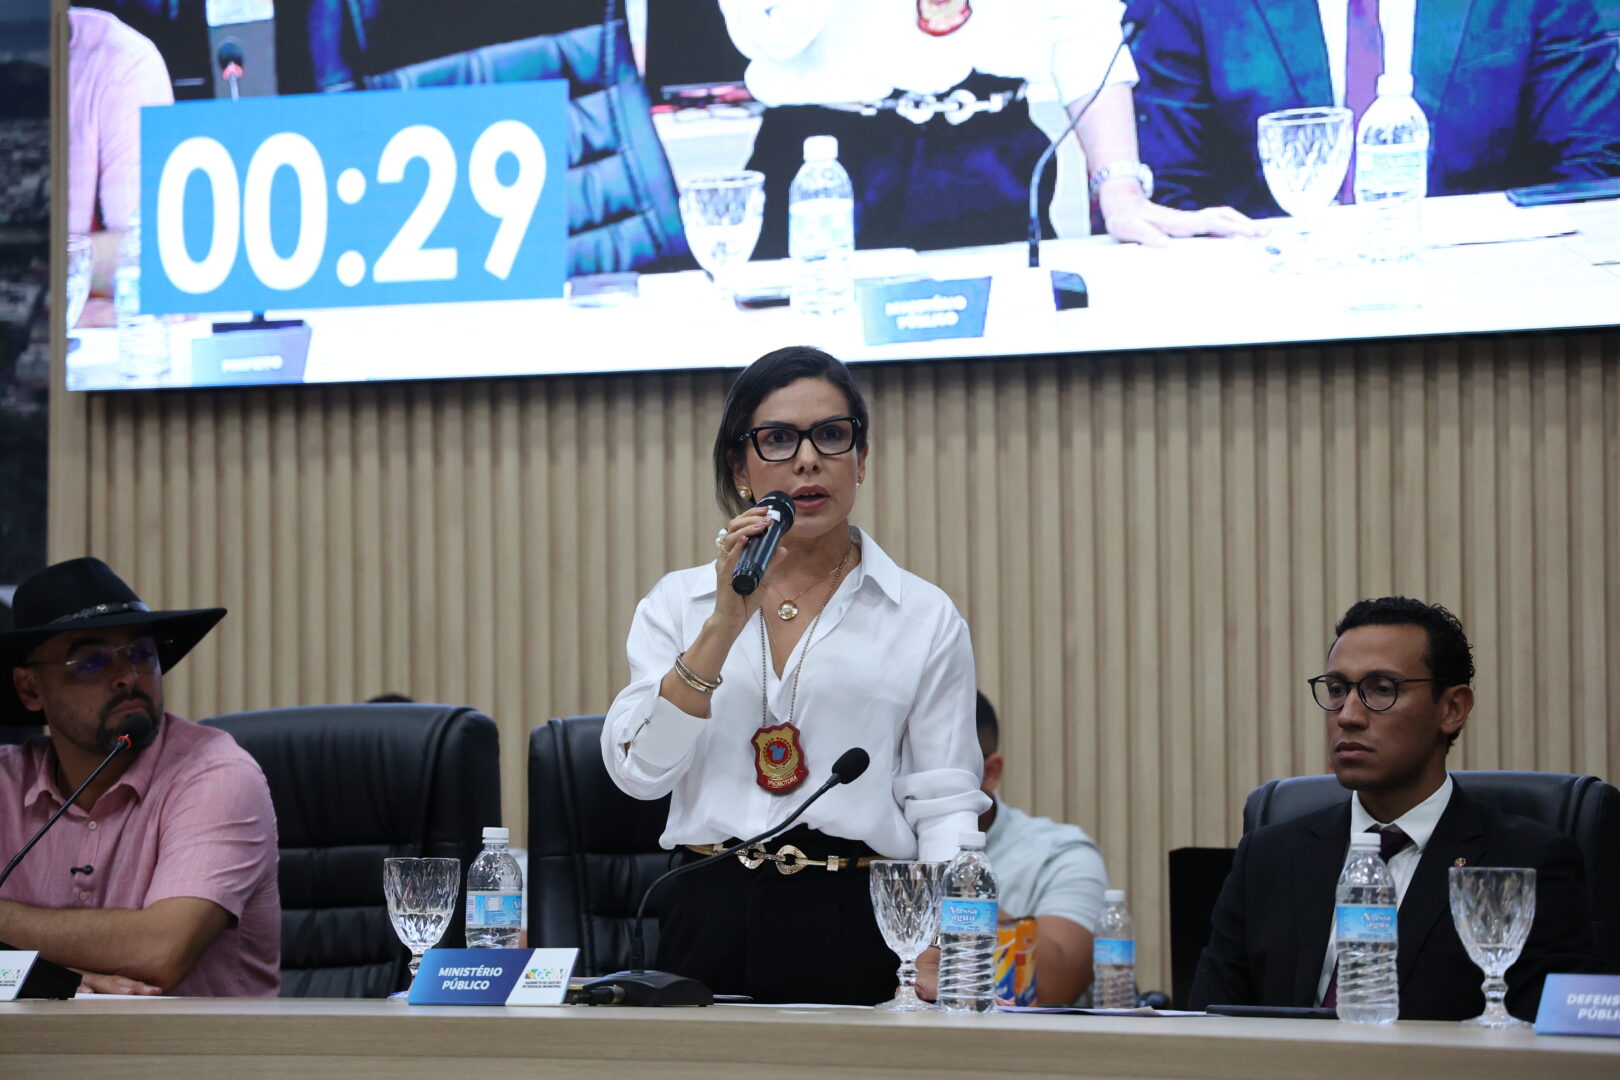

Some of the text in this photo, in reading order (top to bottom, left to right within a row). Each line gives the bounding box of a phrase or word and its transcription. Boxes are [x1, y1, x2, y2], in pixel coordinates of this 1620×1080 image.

[157, 119, 547, 295] 00:29
[438, 964, 503, 977] MINISTÉRIO
[441, 976, 490, 990] PÚBLICO
[1577, 1005, 1620, 1020] PÚBLI
